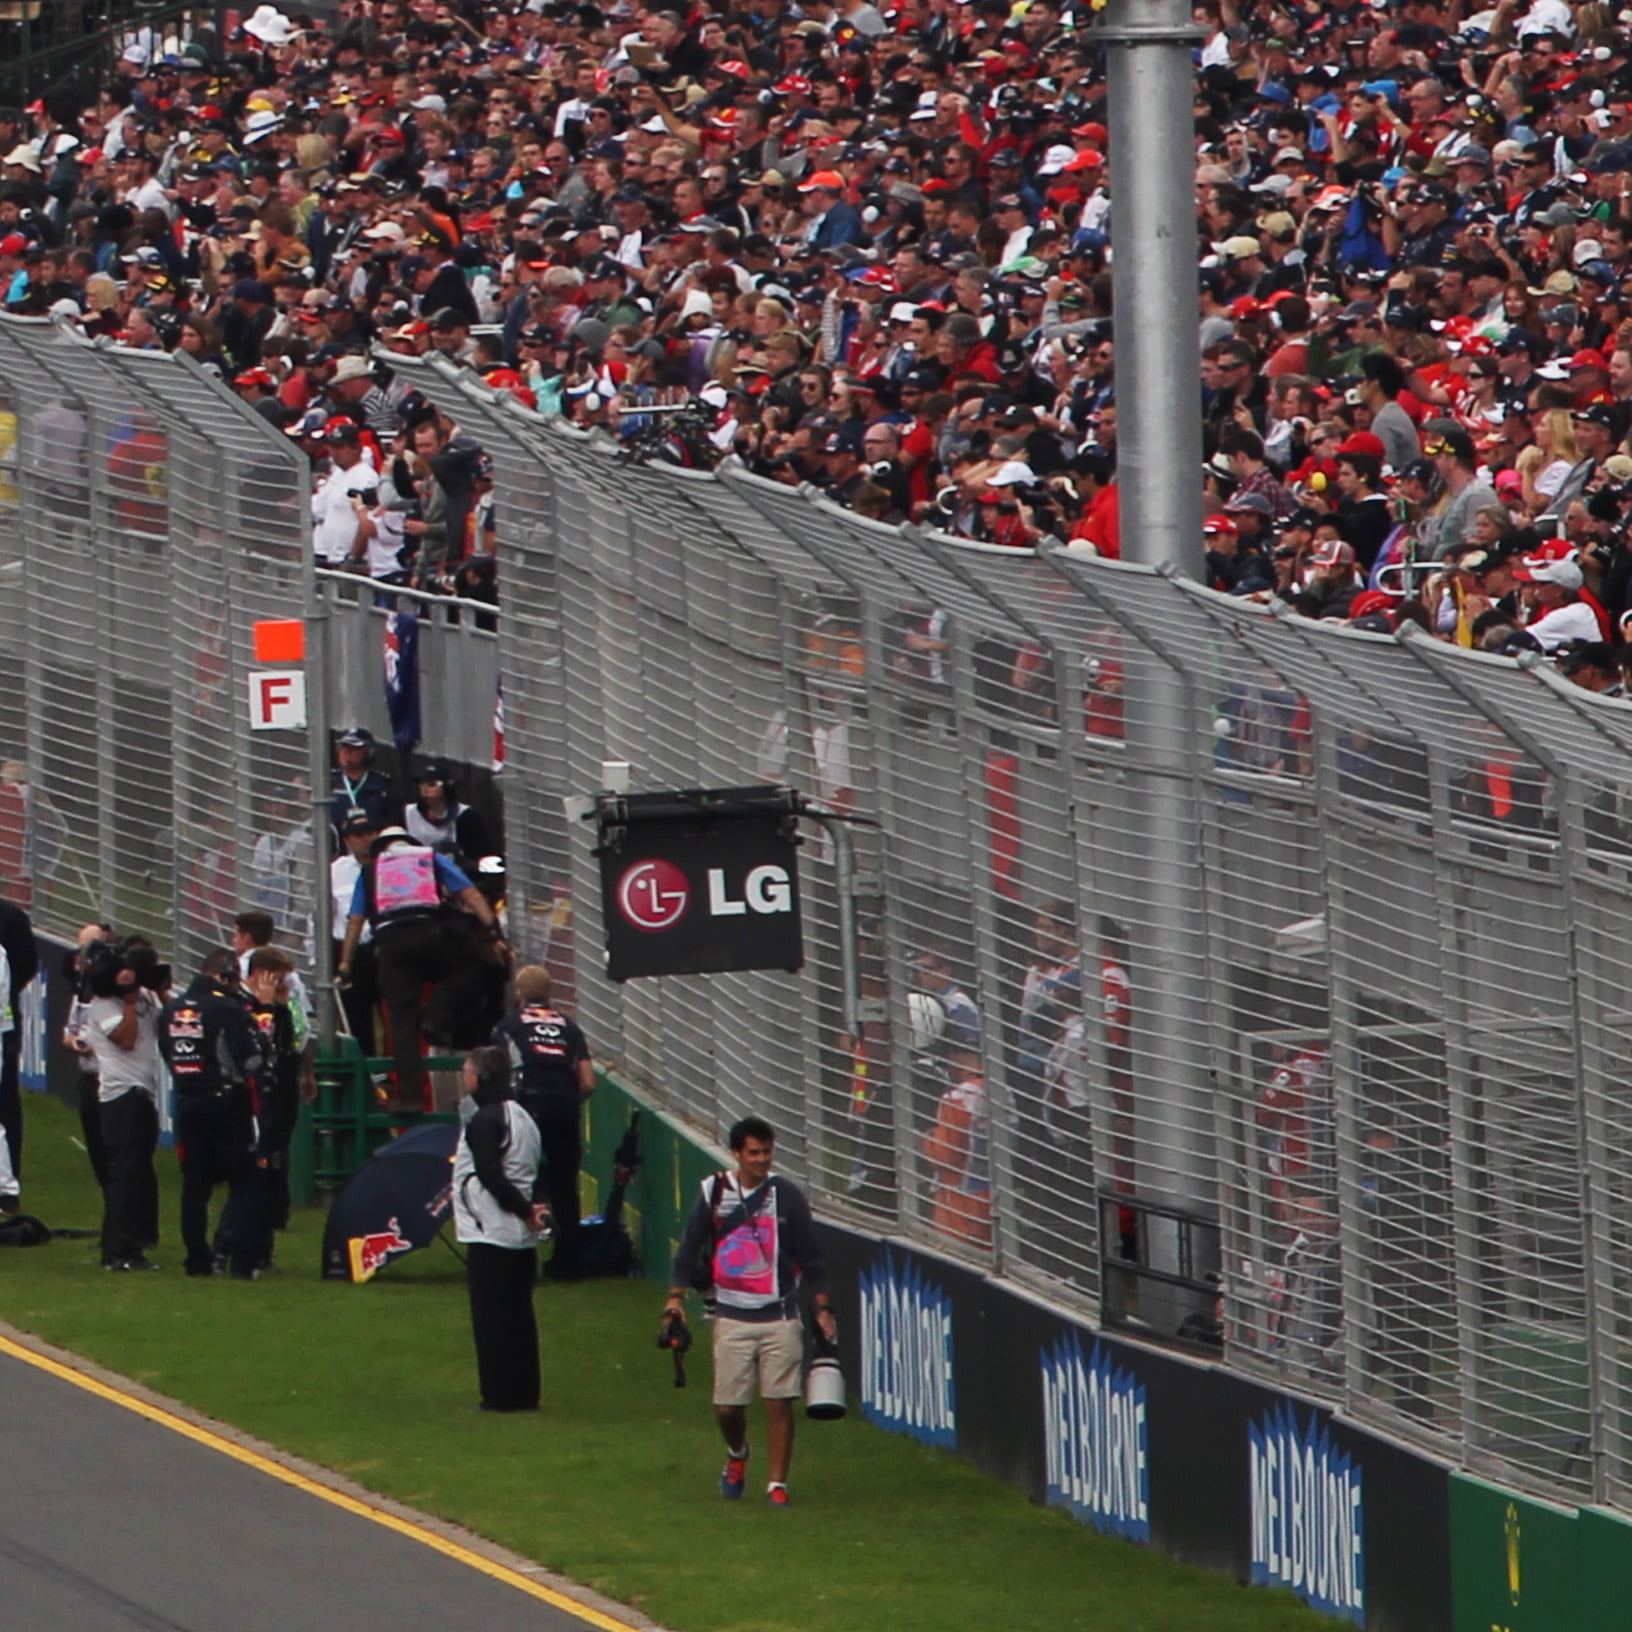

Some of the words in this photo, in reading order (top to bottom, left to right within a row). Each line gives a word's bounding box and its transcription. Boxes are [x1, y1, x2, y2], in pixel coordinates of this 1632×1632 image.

[260, 678, 292, 723] F
[709, 865, 791, 915] LG
[861, 1279, 955, 1431] MELBOURNE
[1043, 1358, 1147, 1521] MELBOURNE
[1251, 1435, 1363, 1609] MELBOURNE
